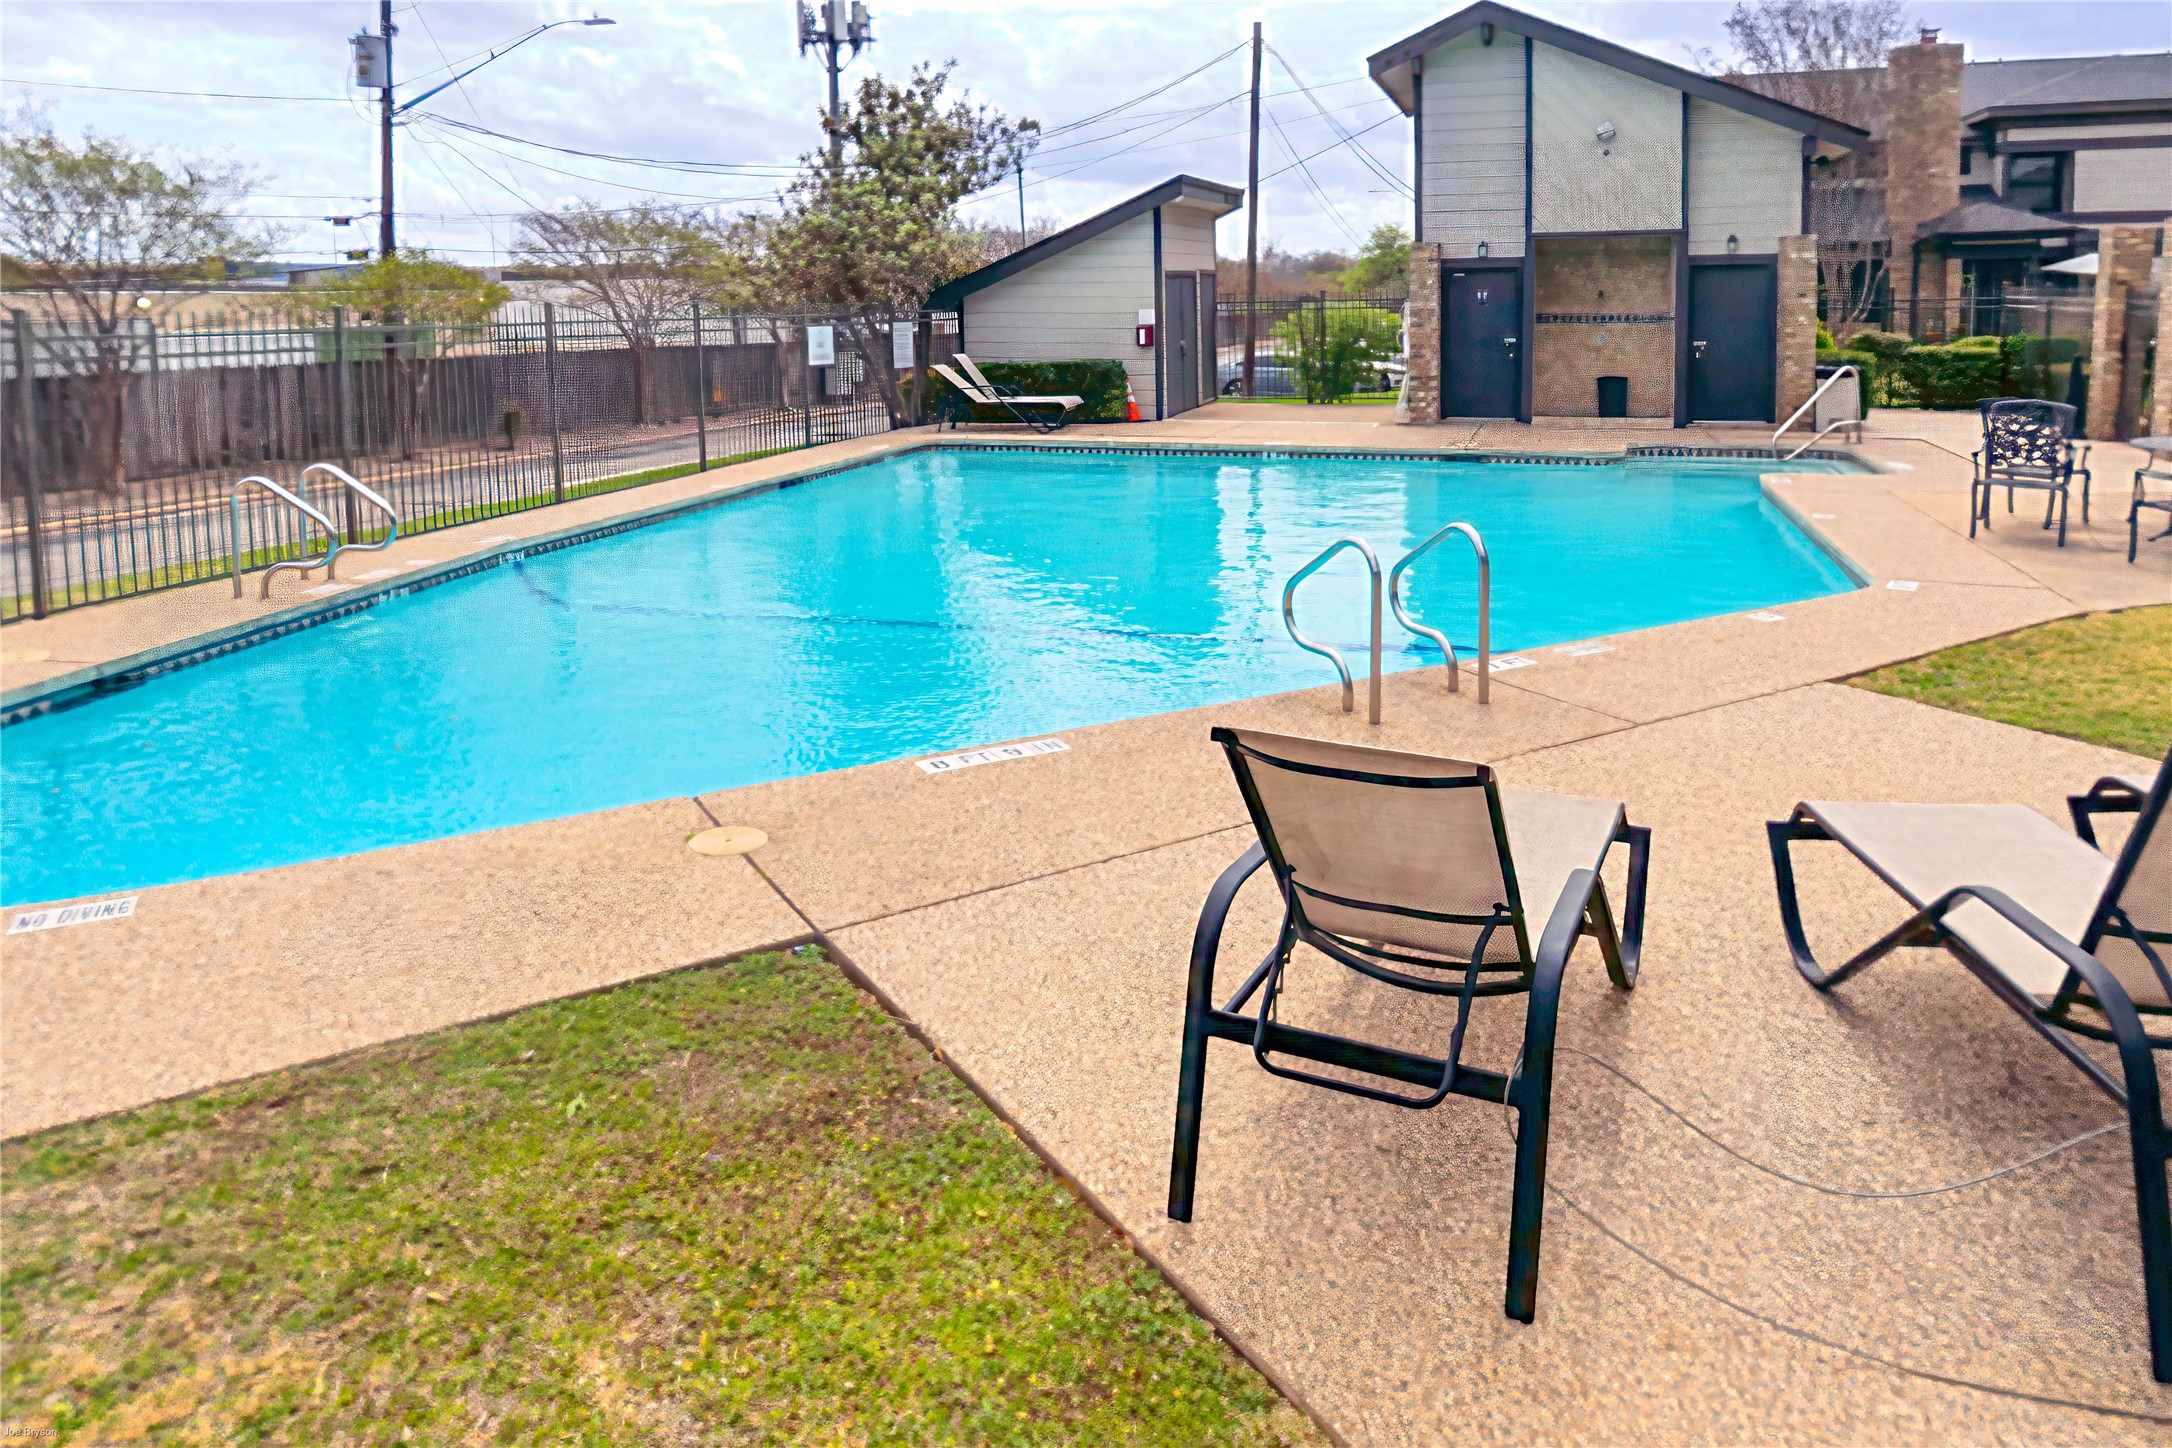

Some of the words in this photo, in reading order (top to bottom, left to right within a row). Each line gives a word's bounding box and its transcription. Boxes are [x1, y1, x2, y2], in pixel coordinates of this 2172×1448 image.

[958, 752, 991, 764] FT
[17, 913, 48, 928] NO
[56, 901, 131, 924] DIVING
